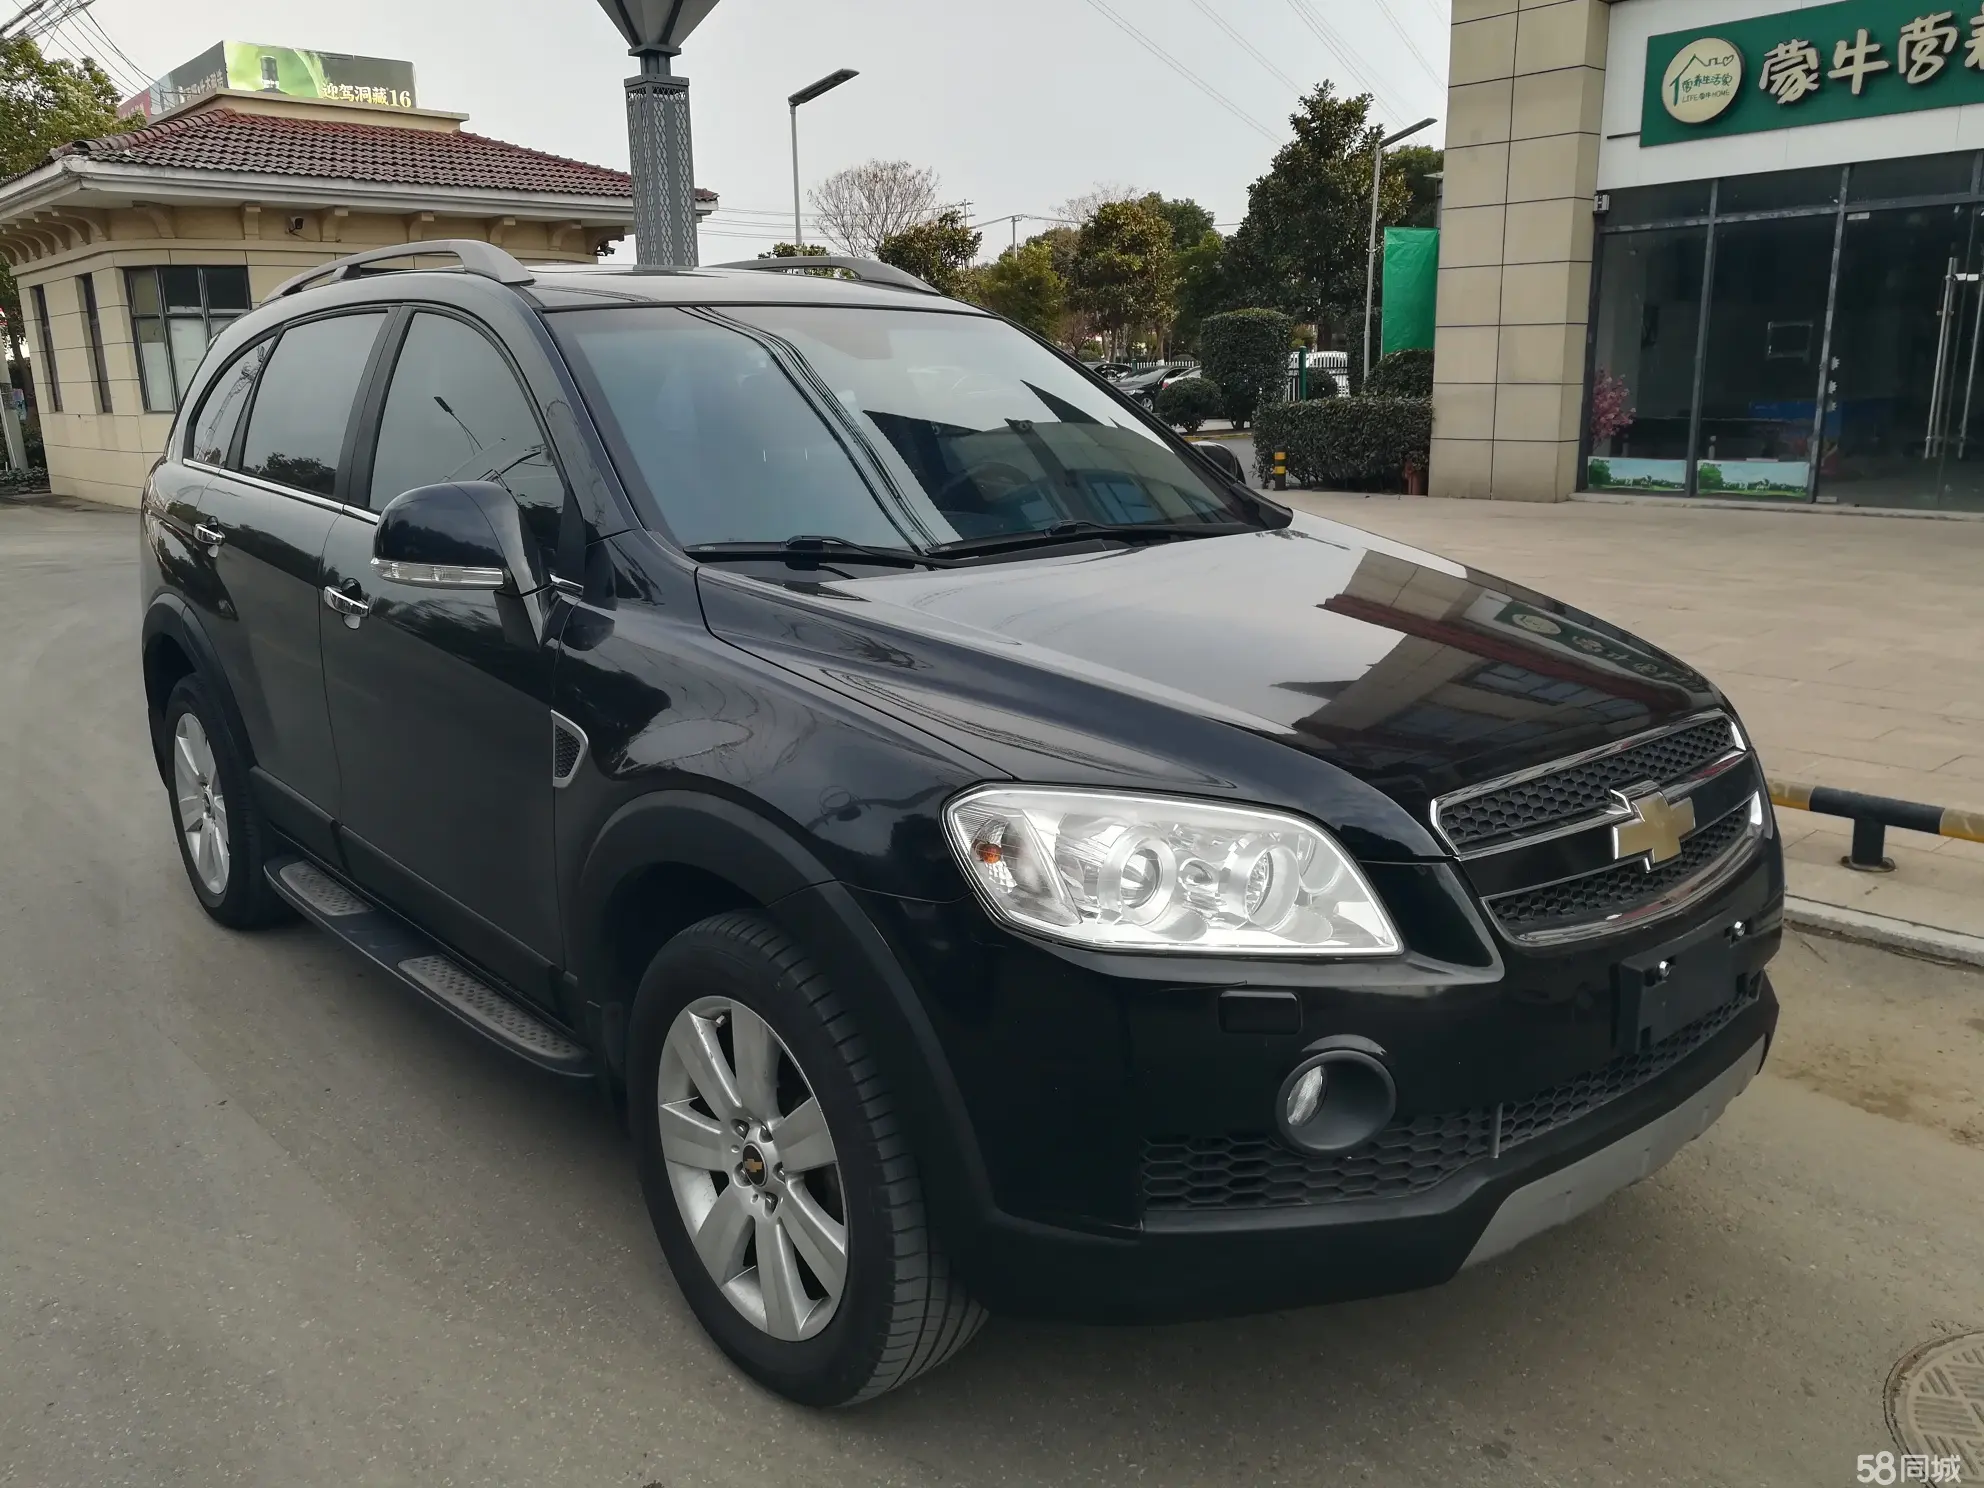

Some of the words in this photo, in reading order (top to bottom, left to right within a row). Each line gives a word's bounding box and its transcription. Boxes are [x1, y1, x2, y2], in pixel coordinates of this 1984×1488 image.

[320, 83, 411, 108] 迎驾洞藏16
[1682, 93, 1698, 103] LIFE
[1712, 89, 1730, 98] HOME
